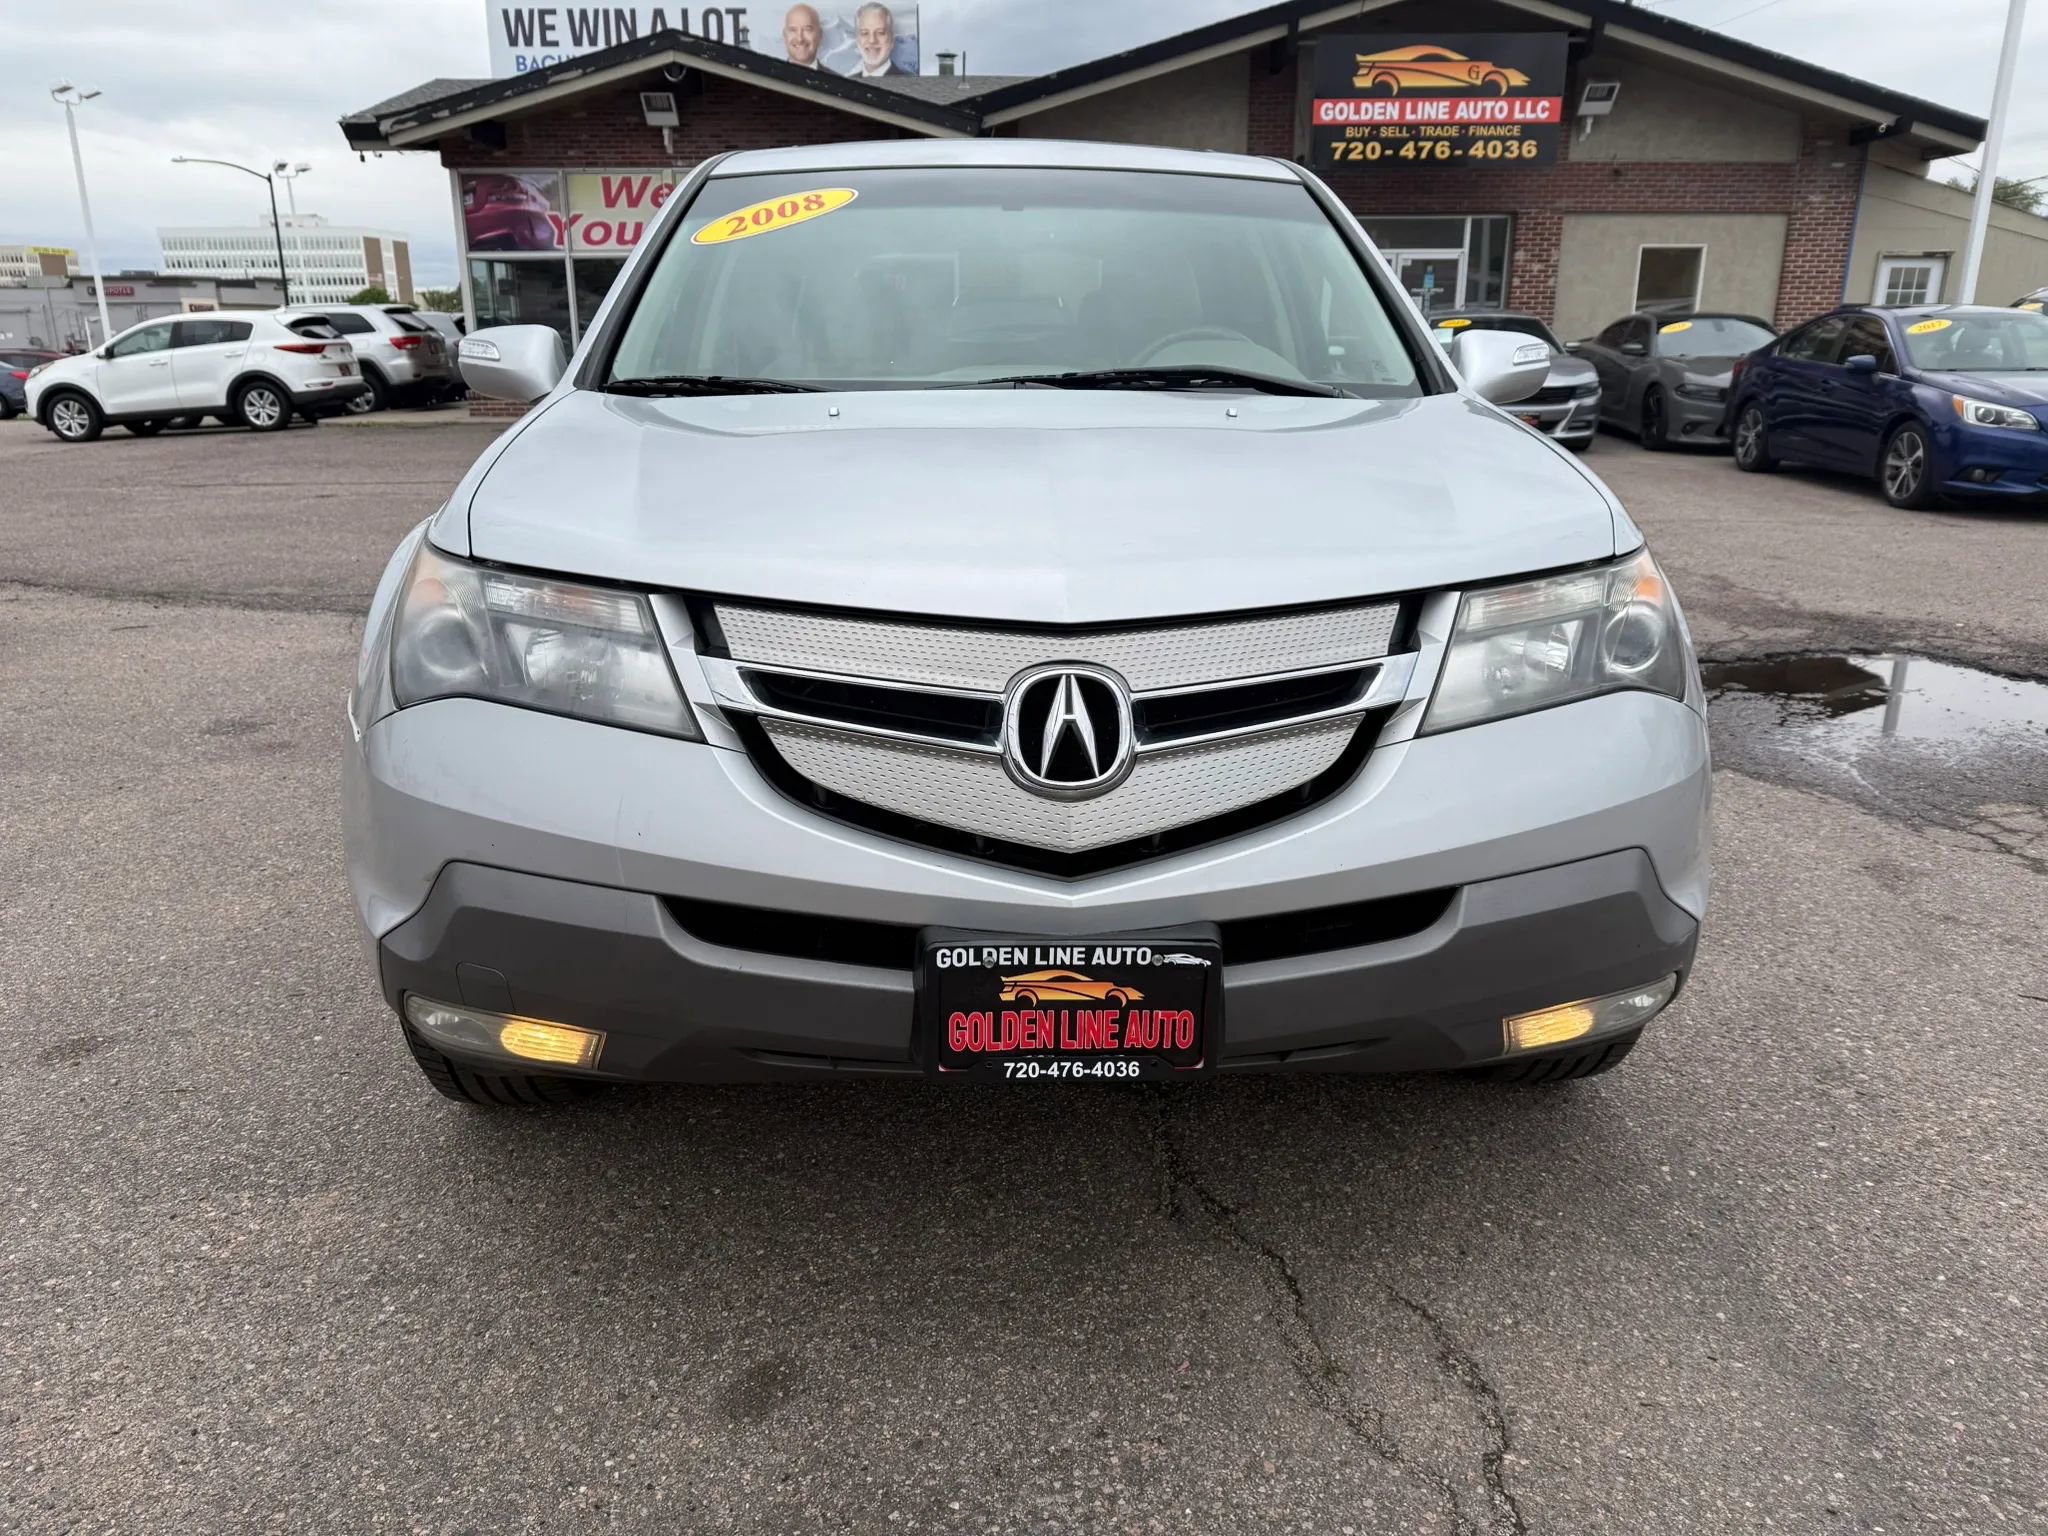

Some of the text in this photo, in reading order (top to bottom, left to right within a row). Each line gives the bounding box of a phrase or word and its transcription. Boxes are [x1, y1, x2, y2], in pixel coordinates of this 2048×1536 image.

[501, 8, 560, 47] WE
[566, 8, 638, 47] WIN
[1467, 64, 1480, 80] G
[1319, 99, 1551, 121] GOLDEN LINE AUTO LLC
[1345, 125, 1521, 138] BUY SELL TRADE FINANCE
[601, 175, 678, 209] We
[725, 193, 826, 237] 2008
[547, 213, 645, 247] You
[936, 946, 1152, 969] GOLDEN LINE AUTO
[949, 1009, 1195, 1052] GOLDEN LINE AUTO
[1003, 1061, 1140, 1079] 720-476-4036
